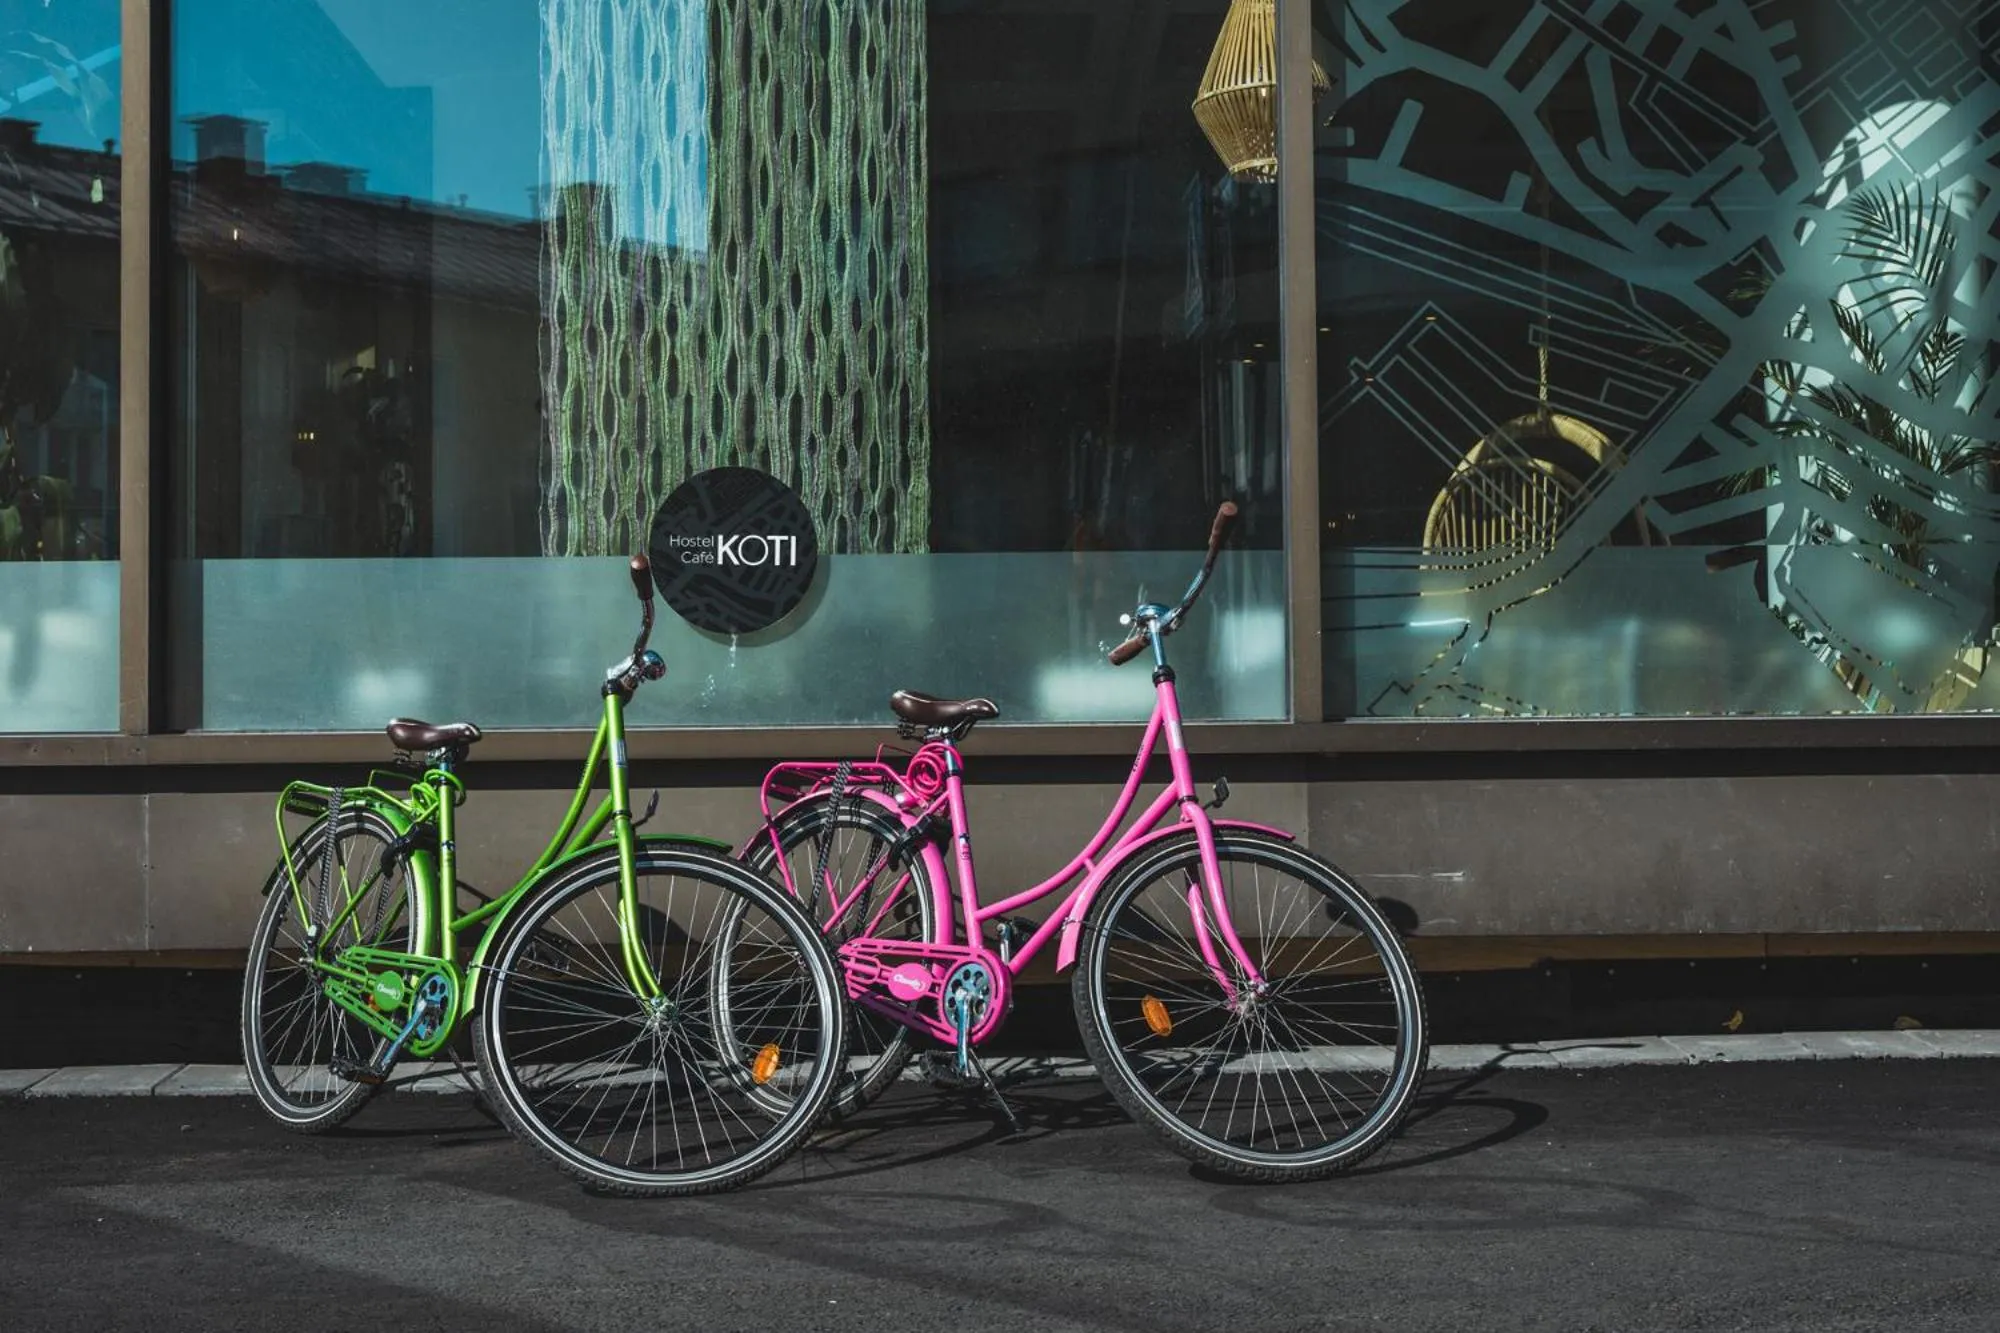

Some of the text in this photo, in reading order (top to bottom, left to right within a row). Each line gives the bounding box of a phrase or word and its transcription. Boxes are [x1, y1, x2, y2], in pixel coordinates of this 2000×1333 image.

[669, 534, 714, 548] Hostel
[717, 534, 797, 566] KOTI
[680, 551, 714, 564] Café
